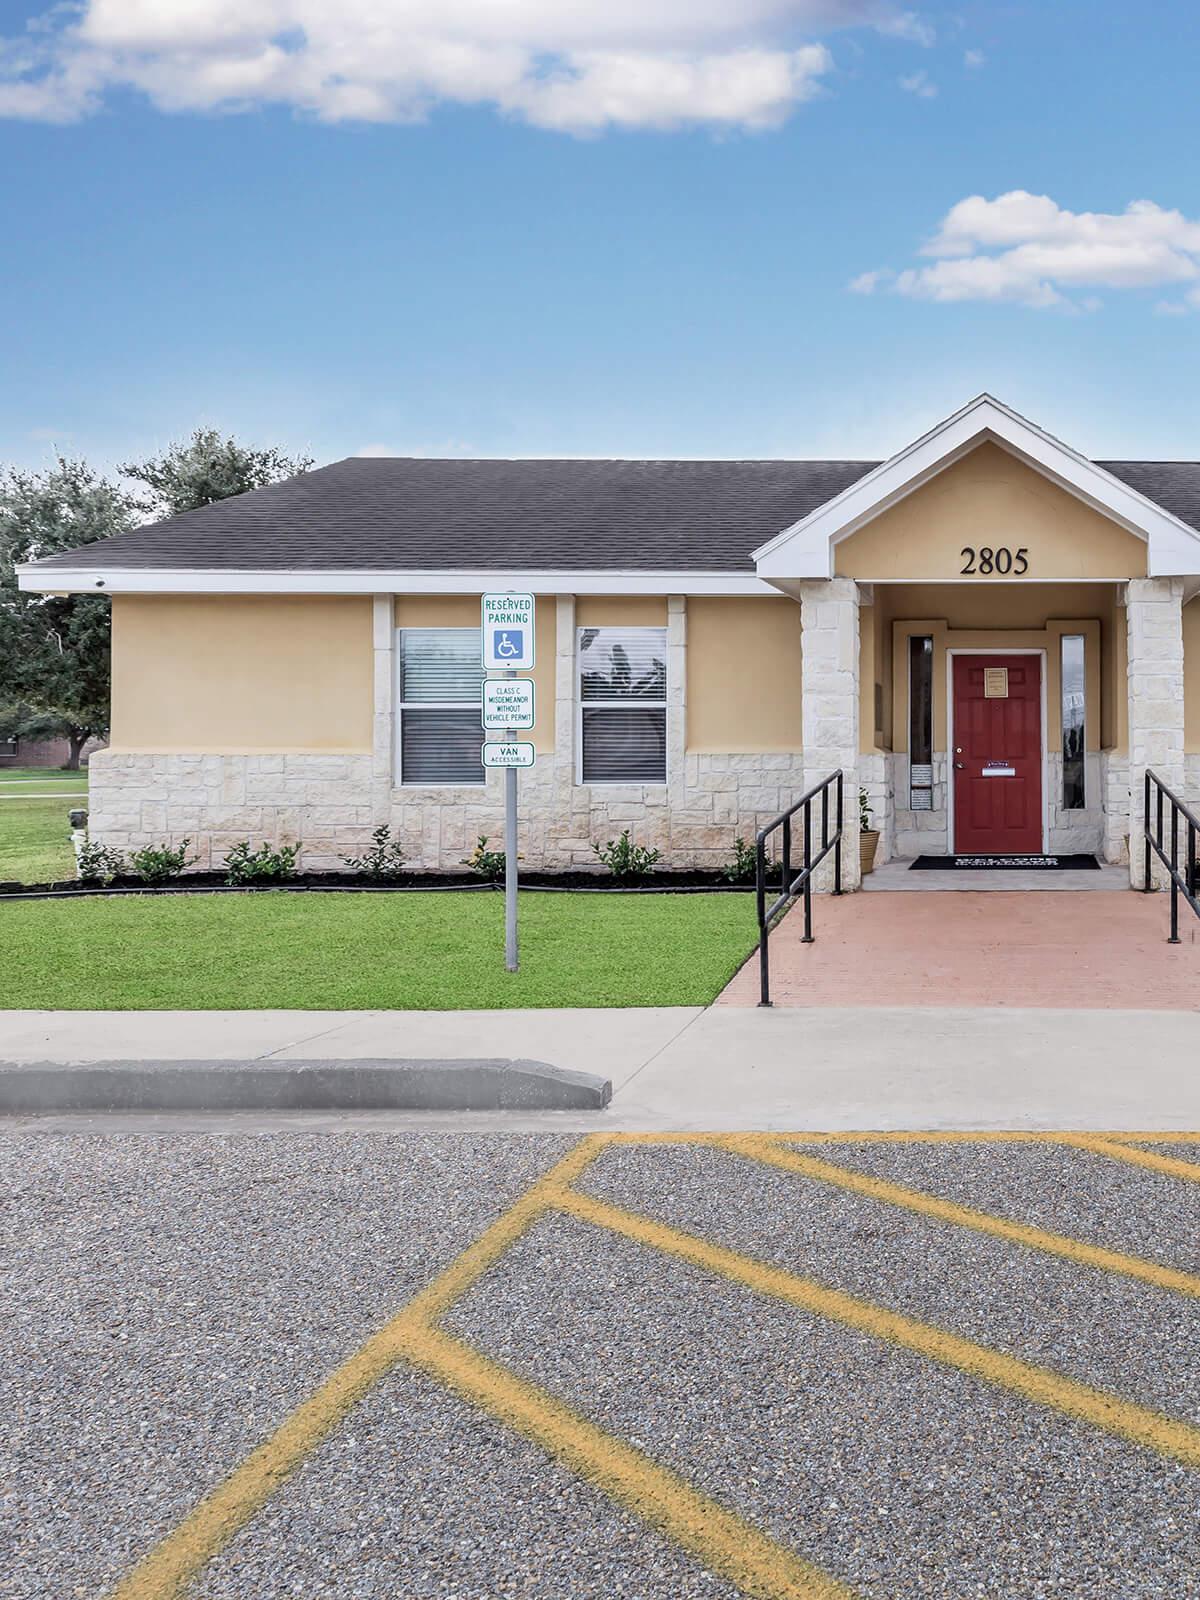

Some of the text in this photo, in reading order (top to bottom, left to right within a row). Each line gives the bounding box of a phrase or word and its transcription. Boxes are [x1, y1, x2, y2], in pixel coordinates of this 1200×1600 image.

[960, 547, 1029, 575] 2805
[486, 600, 530, 610] RESERVED
[488, 614, 528, 624] PARKING
